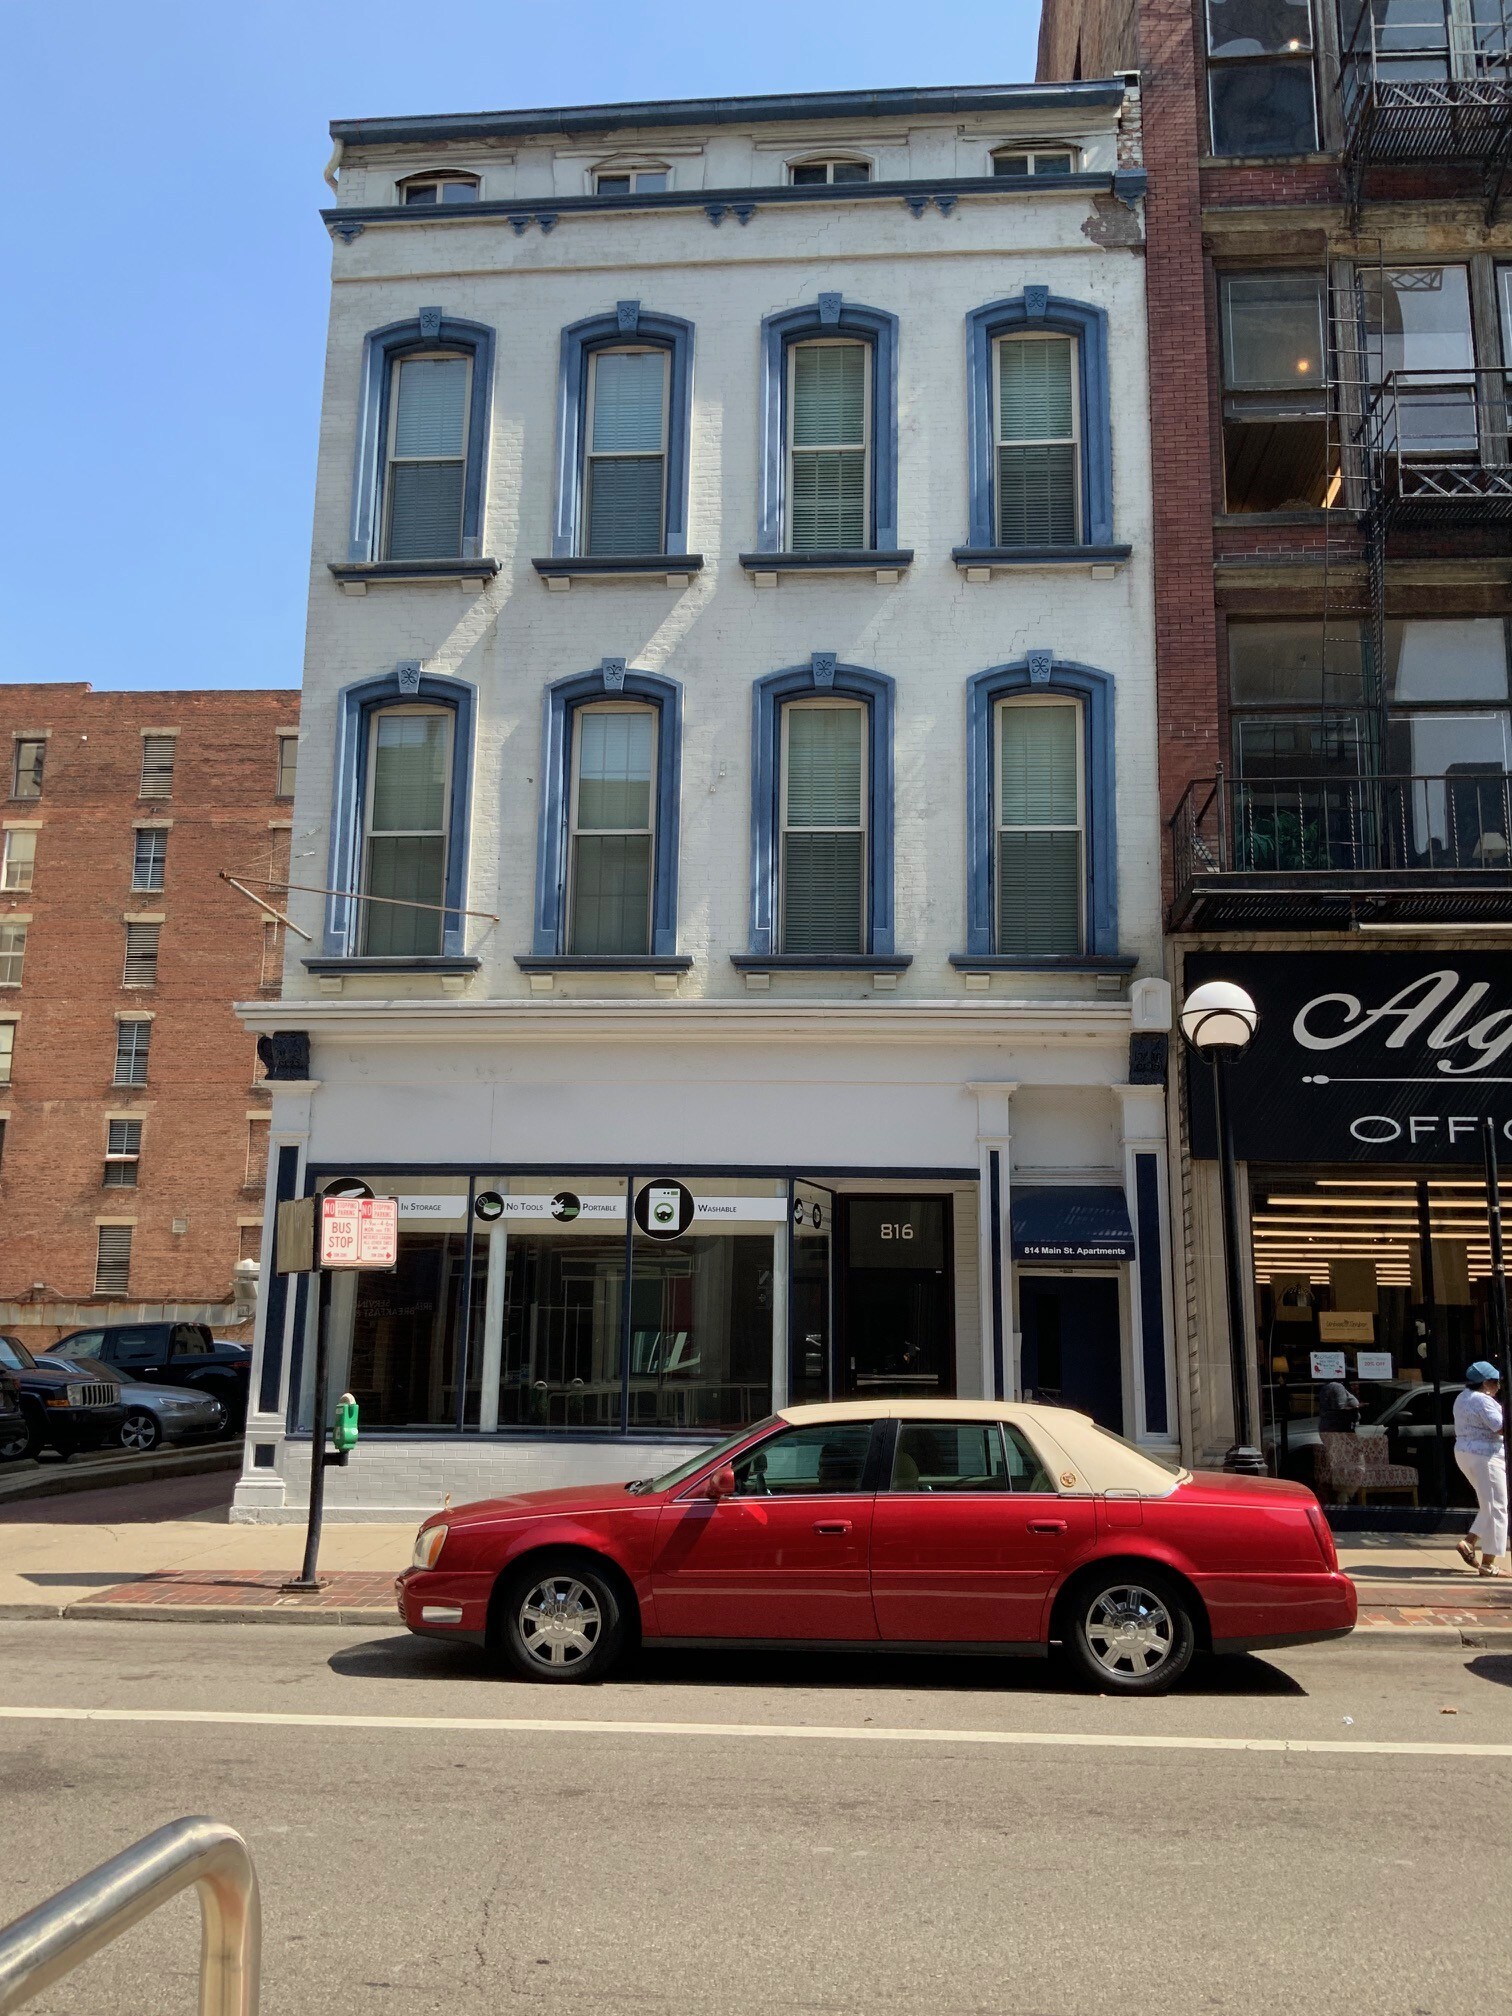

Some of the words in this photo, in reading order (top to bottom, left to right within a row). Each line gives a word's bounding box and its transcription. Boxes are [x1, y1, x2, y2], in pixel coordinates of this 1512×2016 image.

[1292, 969, 1512, 1074] Alg
[1350, 1115, 1512, 1143] OFF
[324, 1203, 335, 1215] NO
[362, 1204, 372, 1216] NO
[332, 1222, 351, 1233] BUS
[881, 1223, 914, 1239] 816
[328, 1236, 353, 1248] STOP
[1024, 1246, 1040, 1254] 814
[1041, 1246, 1062, 1254] Main
[1076, 1247, 1126, 1256] Apartments
